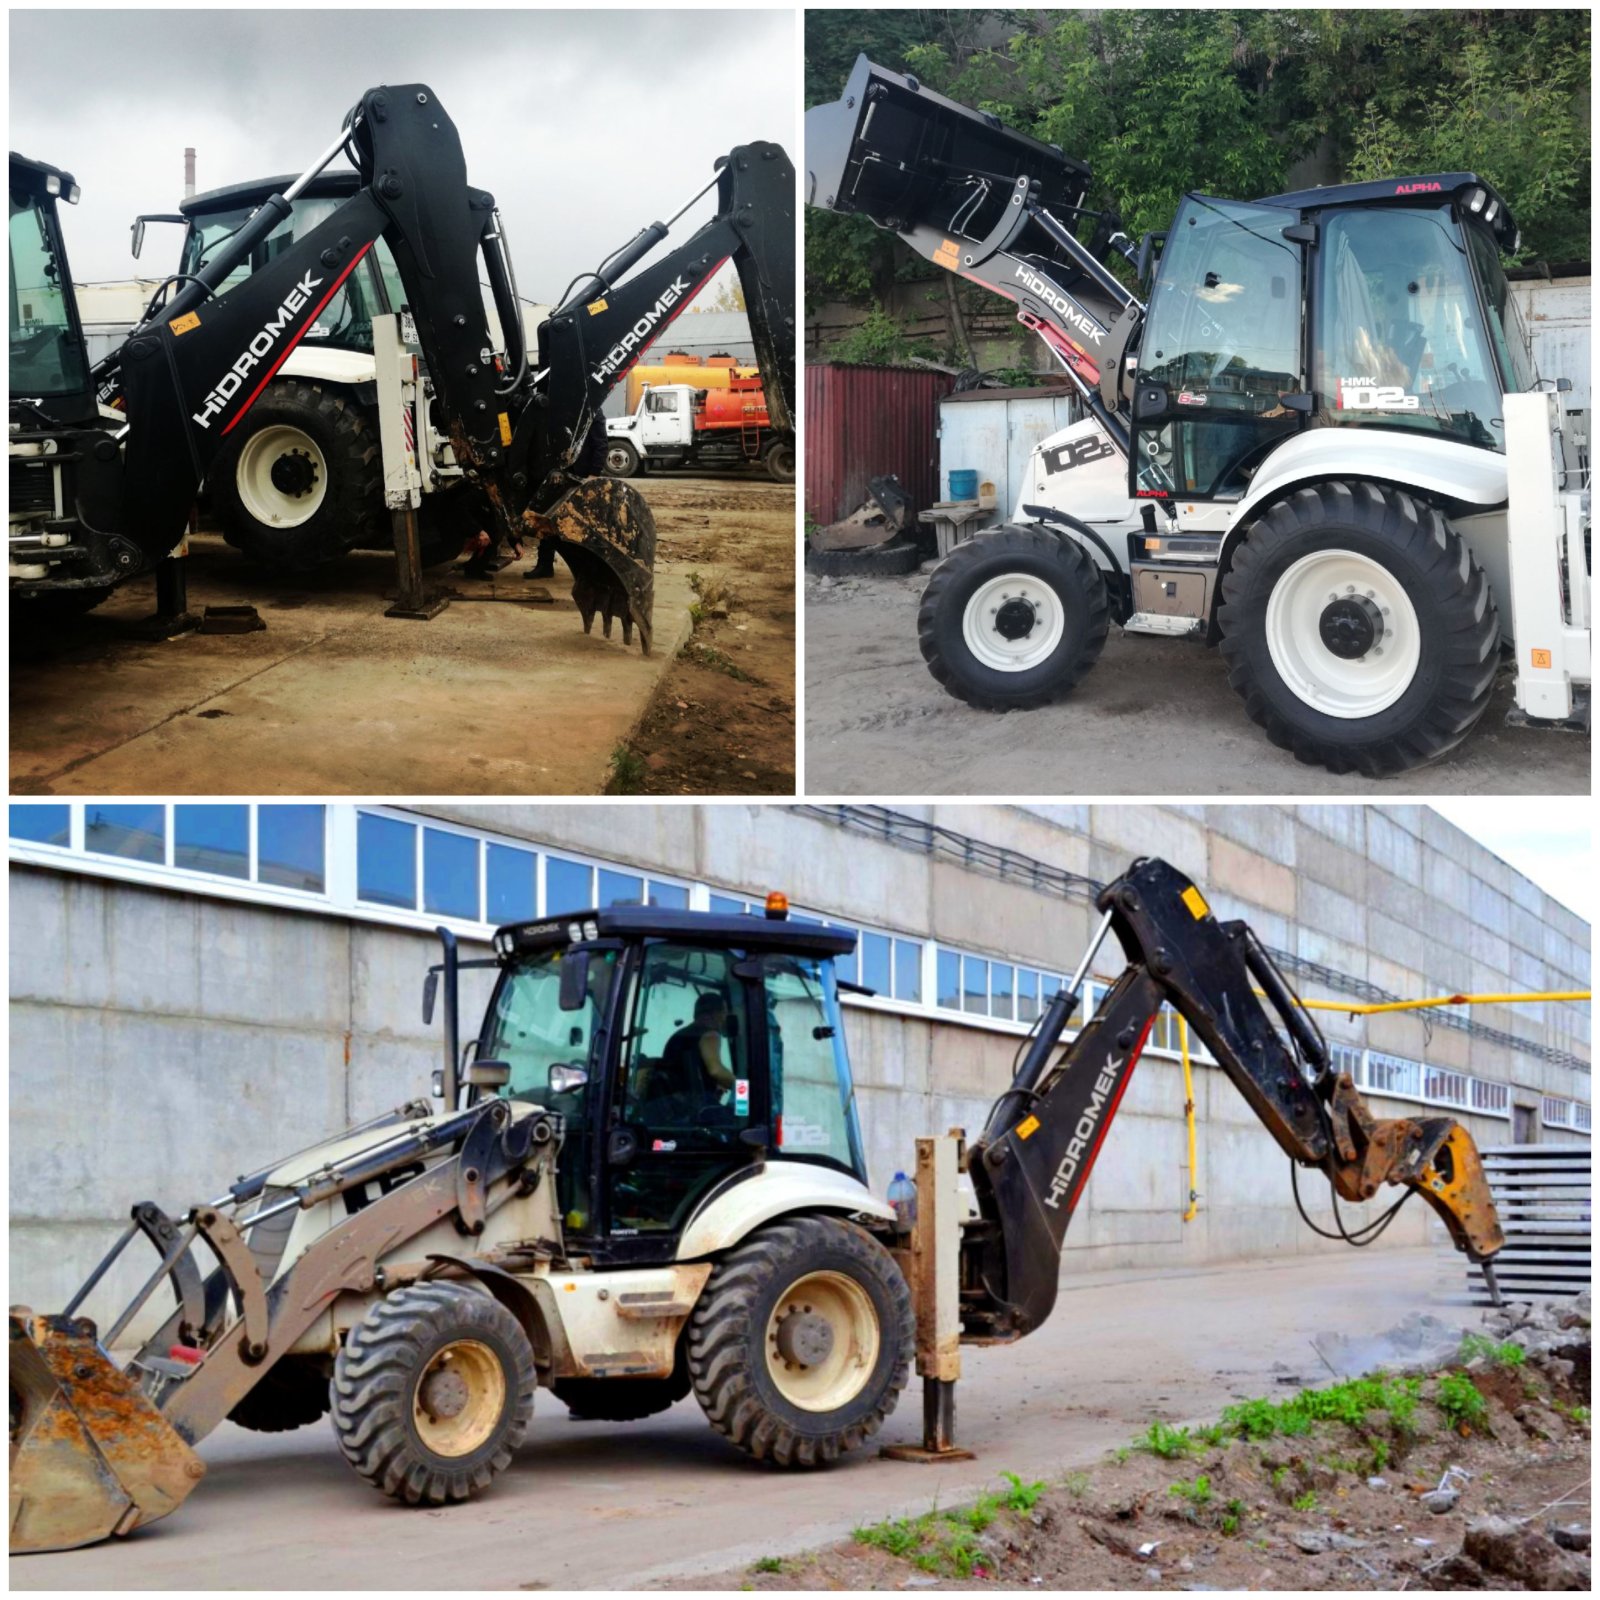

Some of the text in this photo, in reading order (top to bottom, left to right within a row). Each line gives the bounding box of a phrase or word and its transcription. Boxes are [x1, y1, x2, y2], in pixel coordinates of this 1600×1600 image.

[1395, 181, 1442, 195] ALPHA
[1341, 376, 1377, 386] HMK
[1341, 387, 1419, 409] 102B
[1041, 435, 1116, 476] 102B
